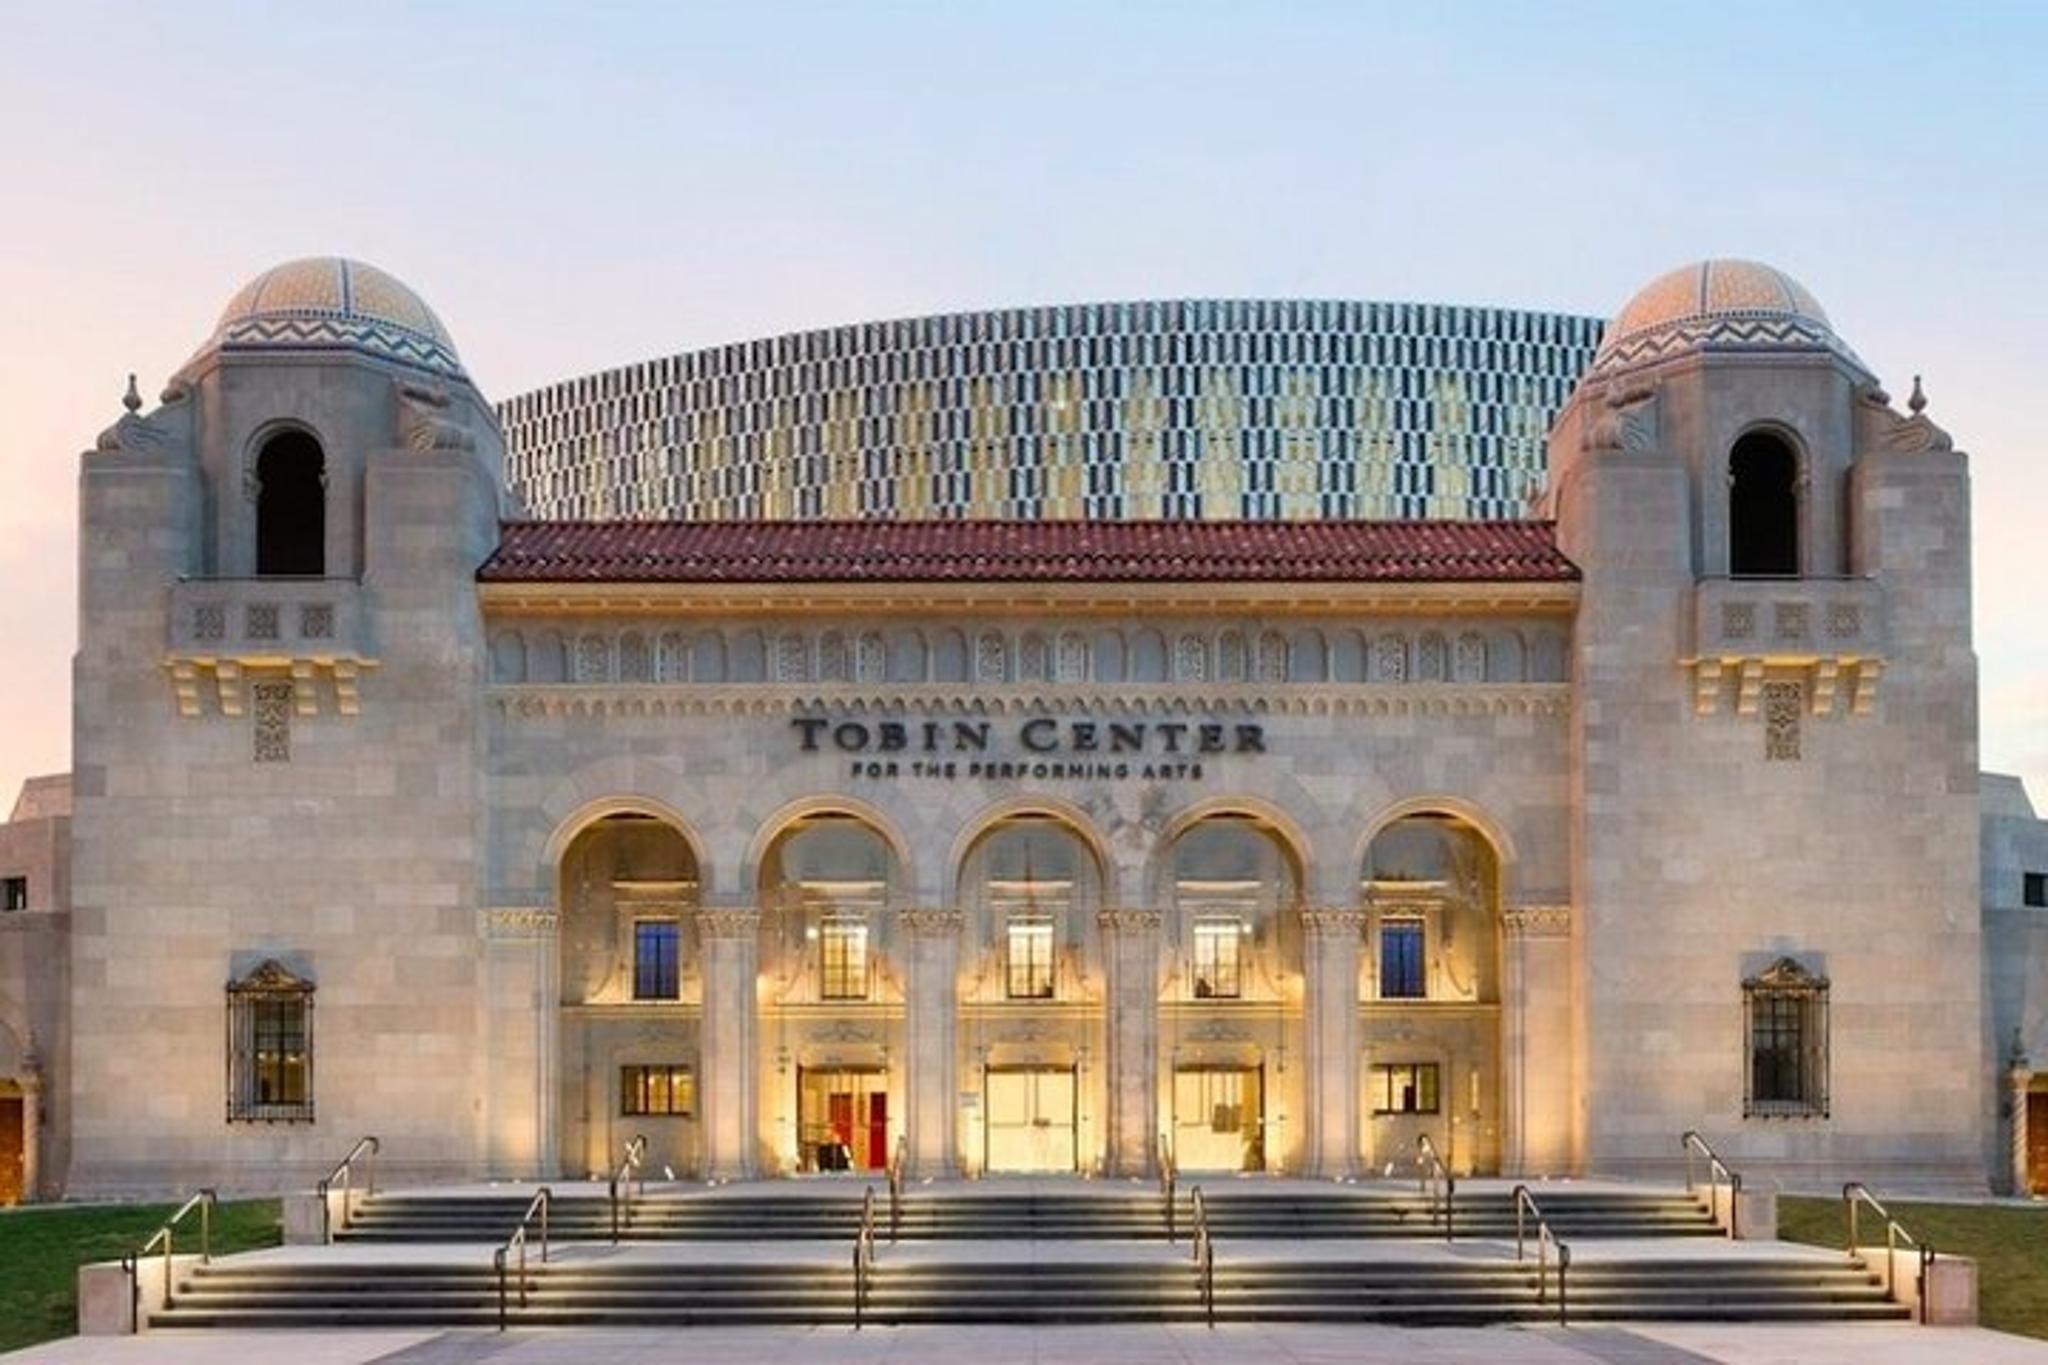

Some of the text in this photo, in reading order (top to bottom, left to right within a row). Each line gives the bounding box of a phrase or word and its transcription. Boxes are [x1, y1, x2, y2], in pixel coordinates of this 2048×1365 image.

[792, 718, 1268, 753] TOBIN CENTER
[851, 762, 1204, 780] FOR THE PERFORMING ARTS
